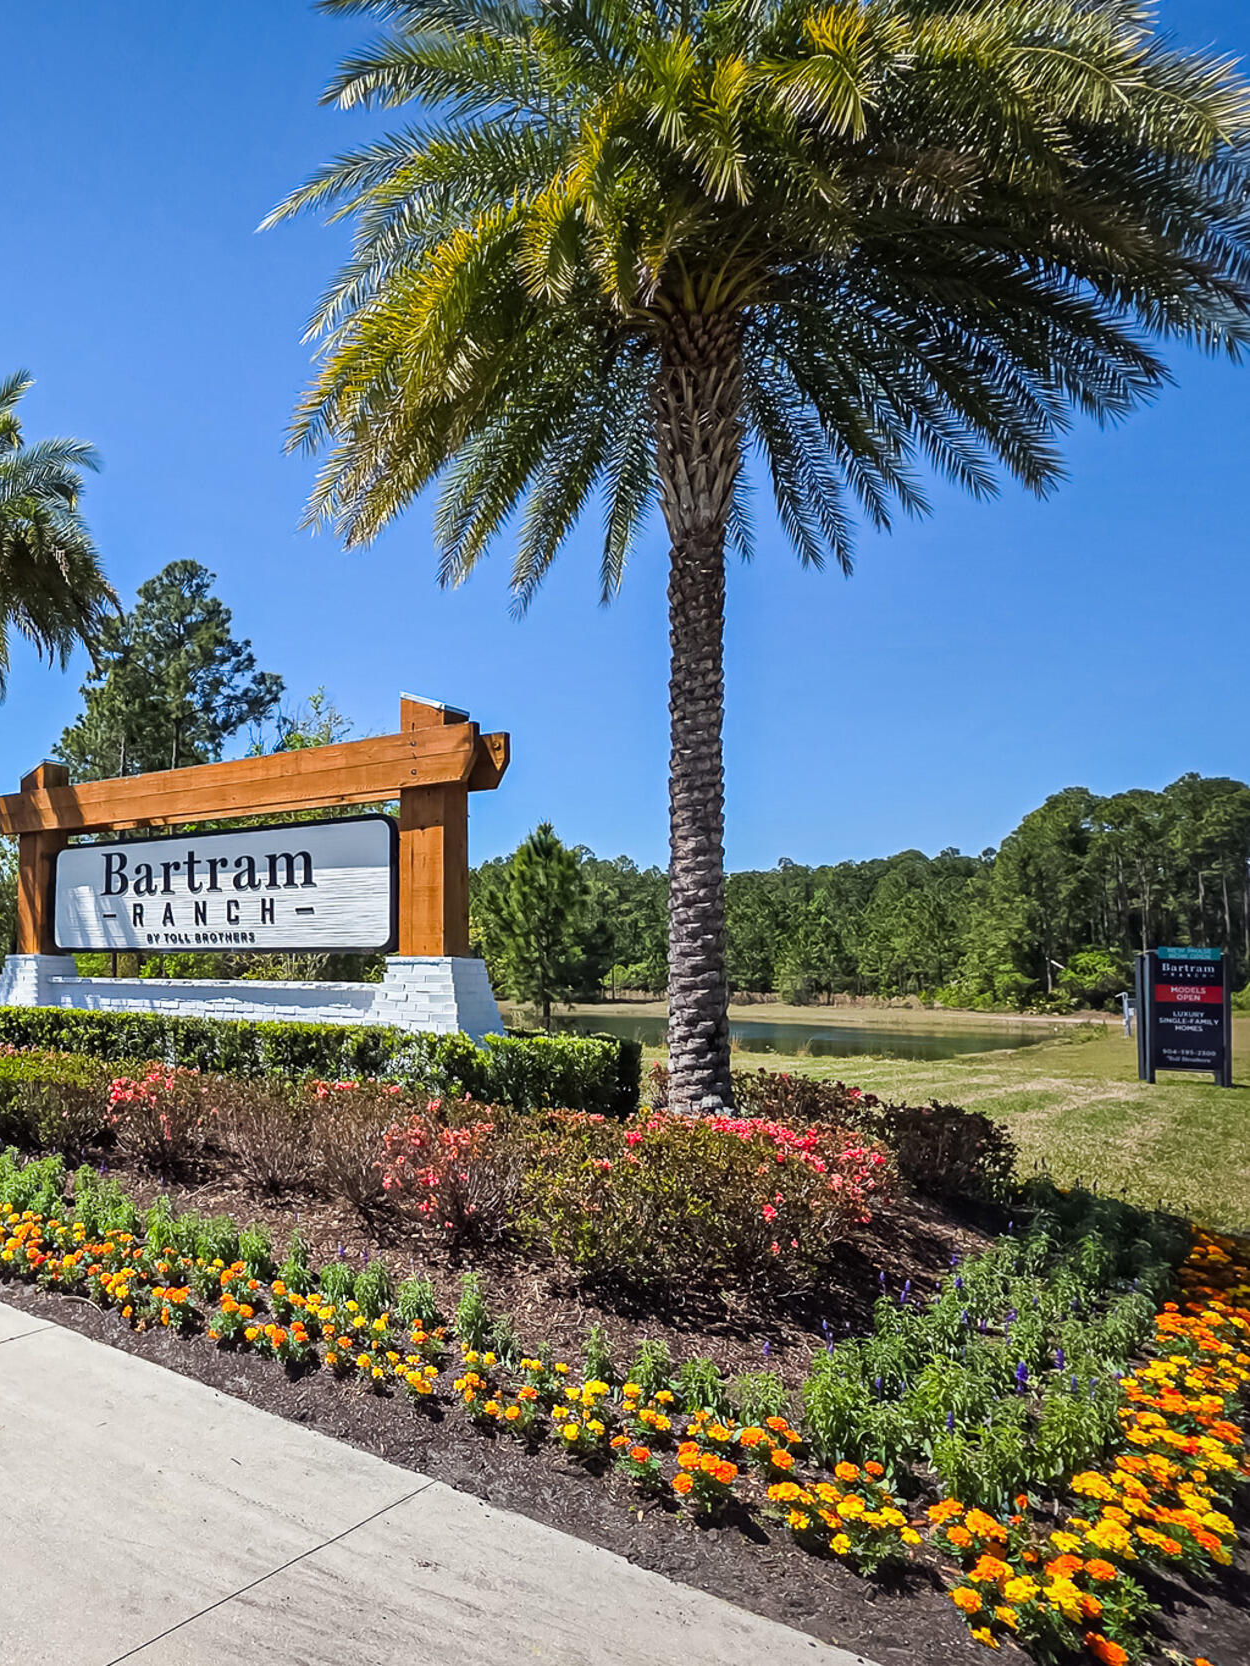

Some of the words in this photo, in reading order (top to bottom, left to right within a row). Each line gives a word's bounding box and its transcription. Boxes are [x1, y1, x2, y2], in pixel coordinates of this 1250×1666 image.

[100, 850, 317, 897] Bartram
[132, 898, 276, 928] RANCH
[147, 934, 160, 944] BY
[164, 933, 191, 944] TOLL
[195, 932, 256, 943] BROTHERS
[1162, 962, 1215, 973] Bartram
[1170, 986, 1206, 995] MODELS
[1158, 1017, 1219, 1025] SINGLE-FAMILY
